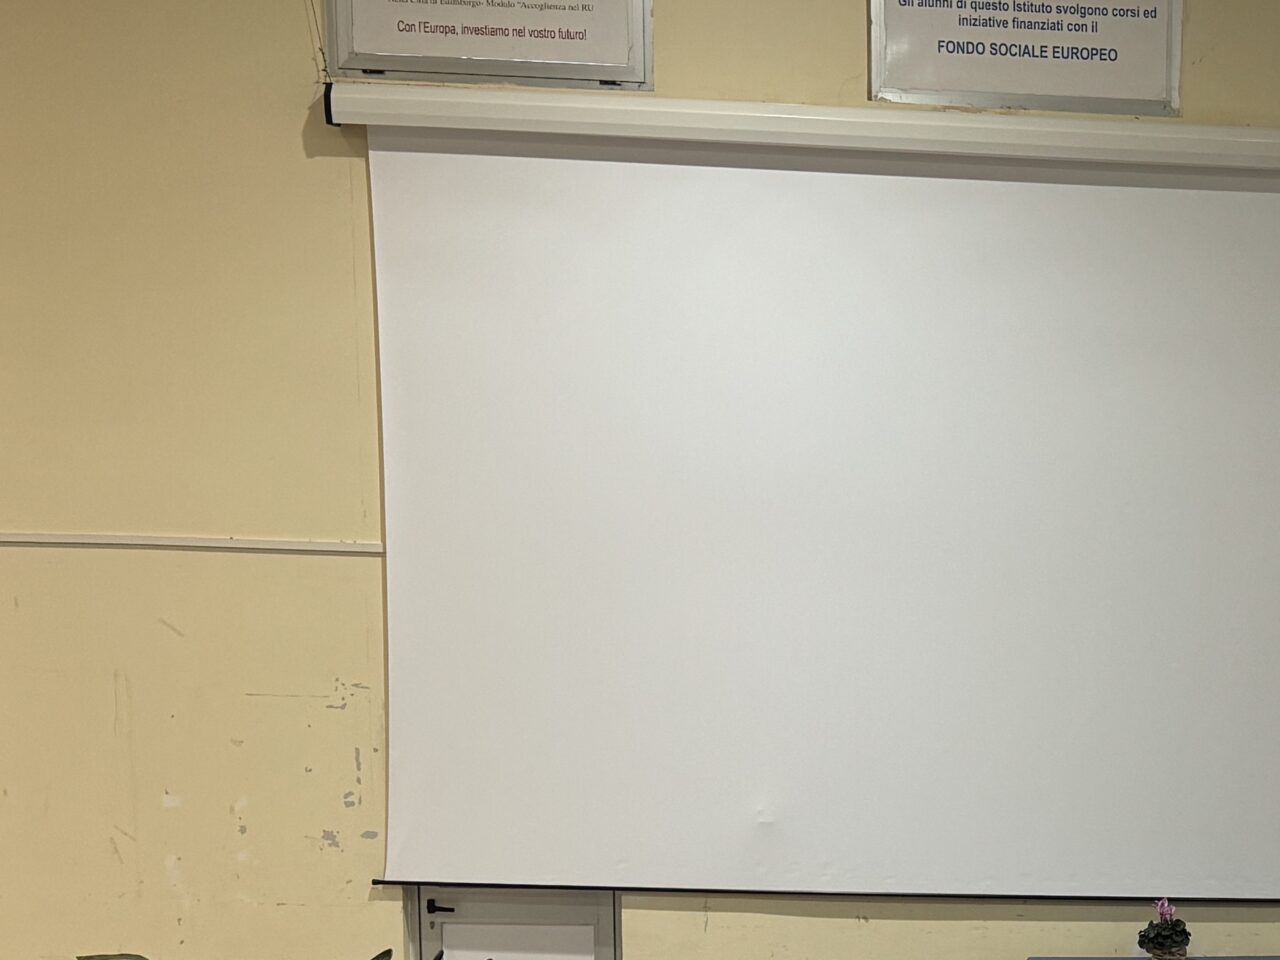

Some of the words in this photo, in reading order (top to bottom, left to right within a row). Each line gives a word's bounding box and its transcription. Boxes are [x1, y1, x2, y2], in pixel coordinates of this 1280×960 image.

[970, 0, 1009, 12] questo
[1013, 0, 1053, 14] Istituto
[1056, 3, 1108, 18] svolgono
[1112, 6, 1140, 18] corsi
[1143, 7, 1157, 19] ed
[397, 20, 416, 33] Con
[461, 23, 510, 37] investiamo
[512, 26, 526, 38] nel
[528, 27, 556, 39] vostro
[558, 28, 587, 41] futuro!
[958, 14, 1009, 29] iniziative
[1012, 16, 1063, 32] finanziati
[1067, 22, 1088, 33] con
[1091, 20, 1099, 33] il
[938, 39, 986, 55] FONDO
[989, 42, 1049, 59] SOCIALE
[1052, 45, 1118, 62] EUROPEO
